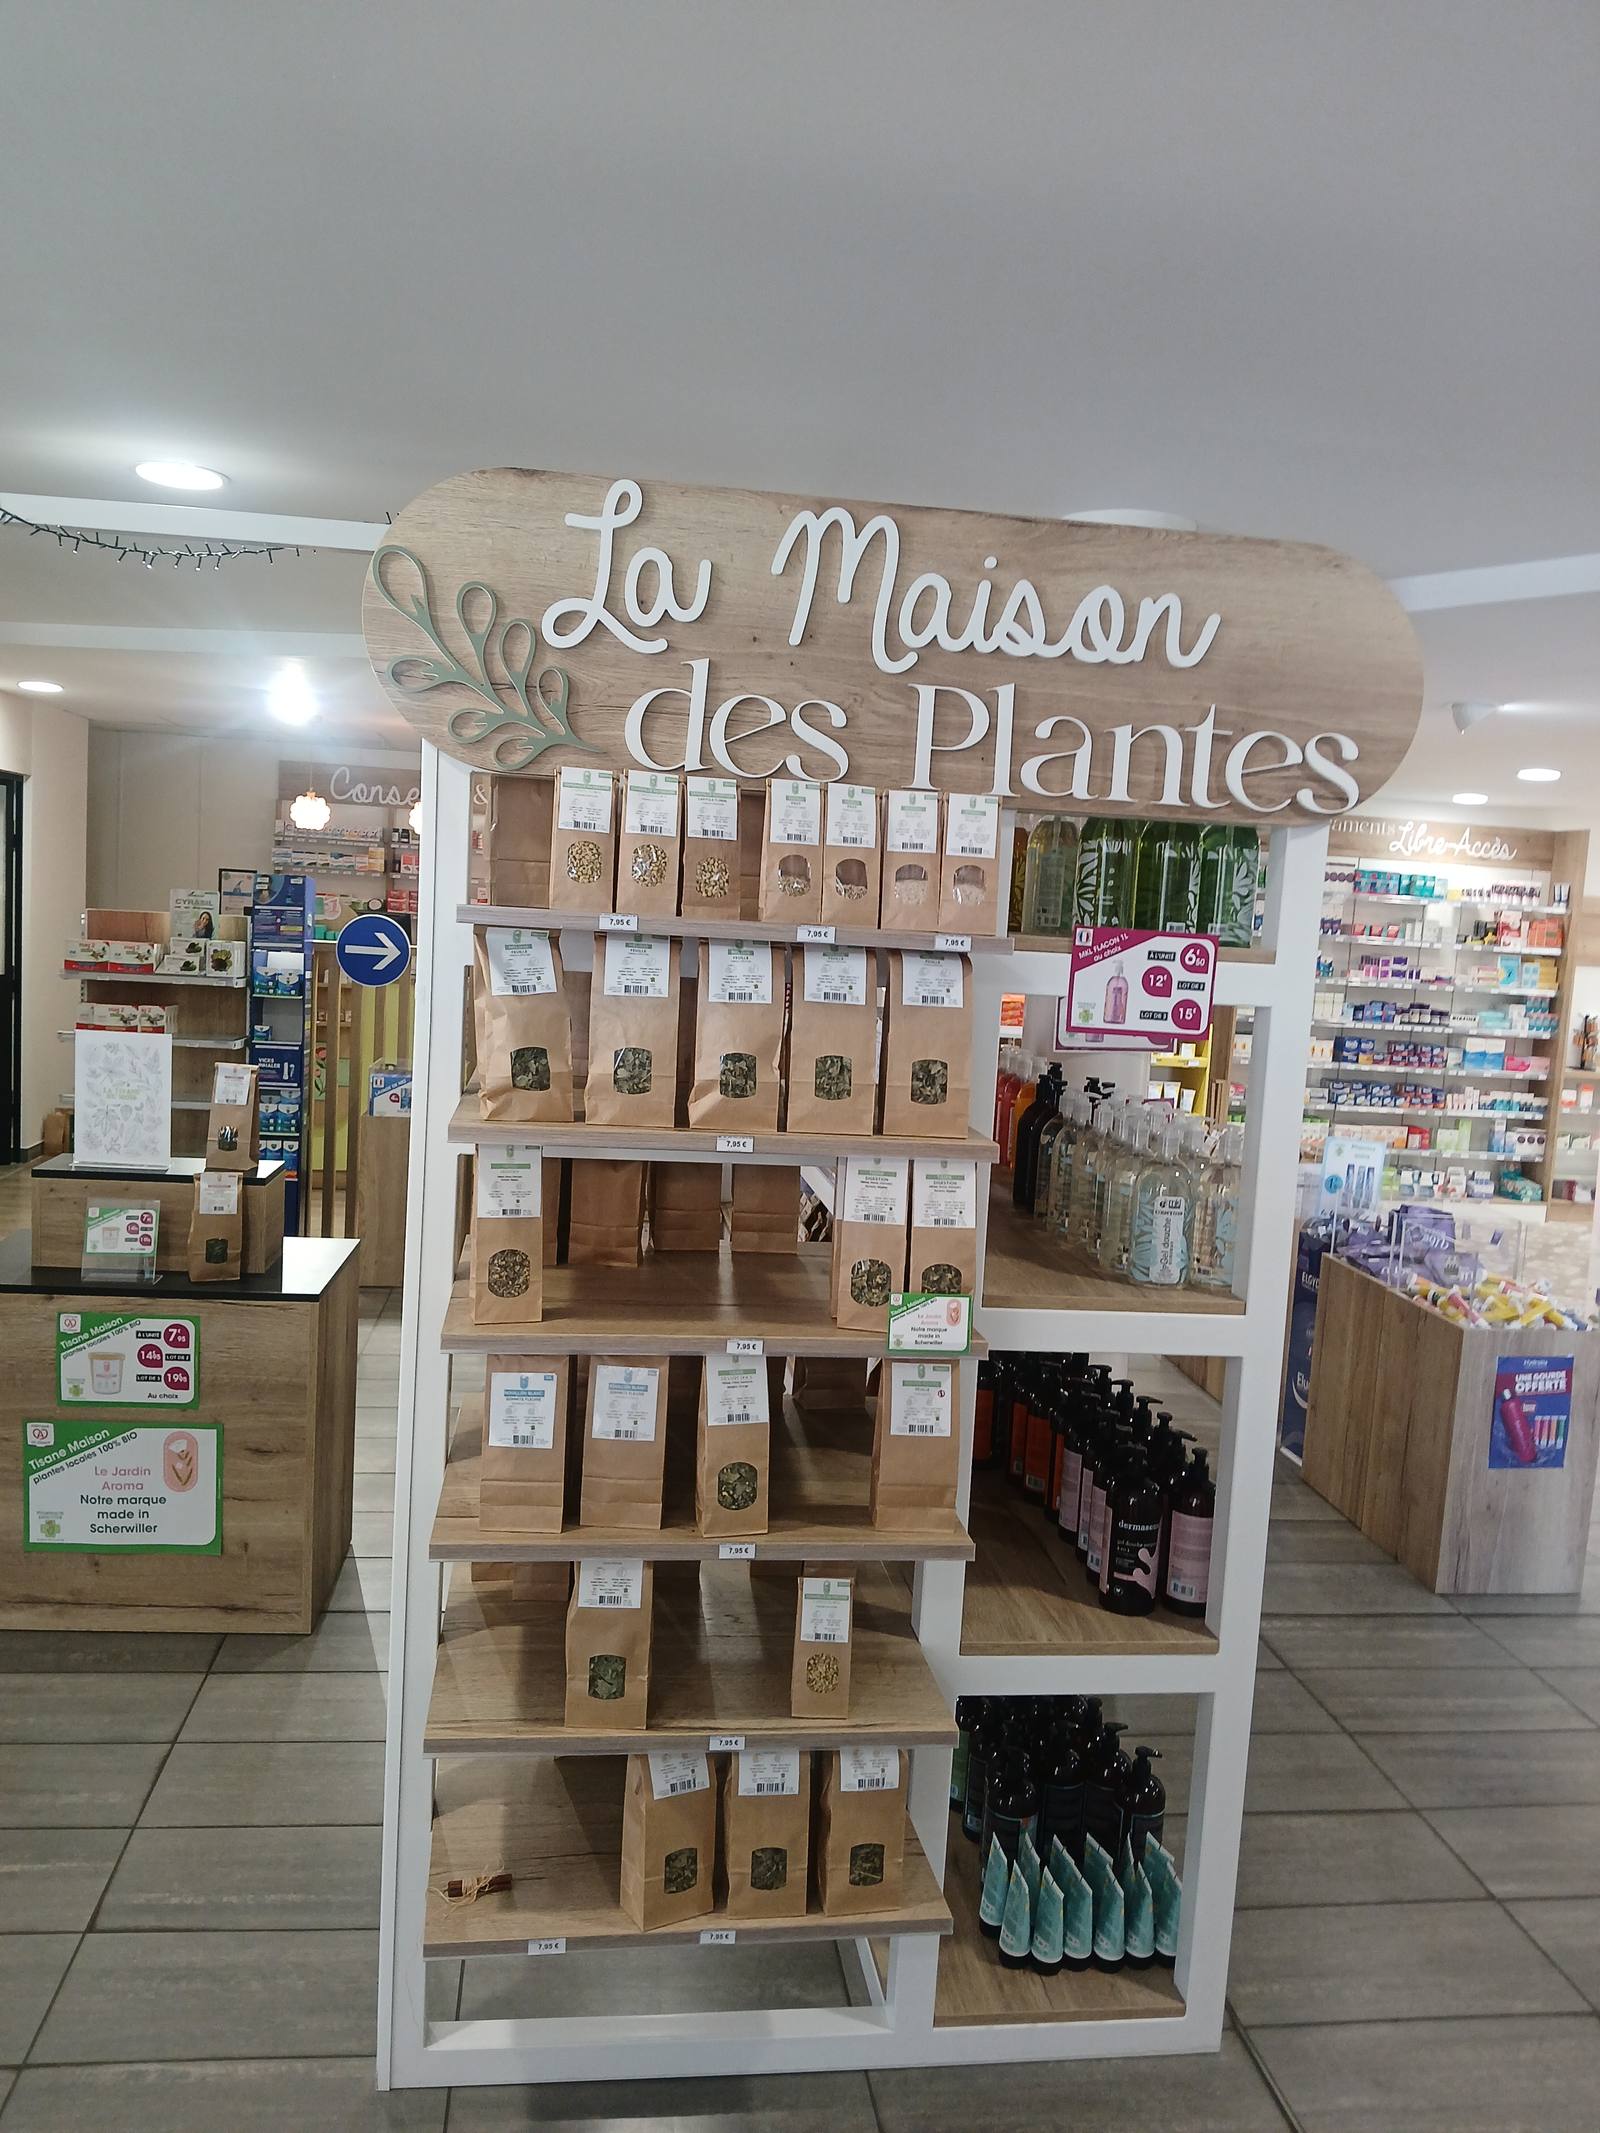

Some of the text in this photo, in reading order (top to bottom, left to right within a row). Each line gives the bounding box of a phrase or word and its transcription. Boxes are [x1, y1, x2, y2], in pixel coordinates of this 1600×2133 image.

[541, 479, 1221, 675] La Maison
[624, 657, 1360, 816] des Plantes
[1388, 820, 1518, 861] Libre-Accès
[1078, 947, 1094, 959] MKL
[1094, 936, 1120, 954] FLACON
[1093, 945, 1122, 962] au choix
[1178, 982, 1190, 990] LOT
[1141, 1011, 1153, 1019] LOT
[61, 1317, 123, 1350] Tisane Maison
[1515, 1370, 1566, 1382] UNE GOURDE
[1515, 1380, 1567, 1393] OFFERTE
[28, 1449, 67, 1471] Tisane
[67, 1428, 110, 1452] Maison
[33, 1431, 138, 1485] plantes locales 100% BIO
[94, 1466, 151, 1477] Le Jardin
[101, 1481, 144, 1491] Aroma
[80, 1494, 167, 1509] Notre marque
[97, 1509, 149, 1519] made in
[89, 1523, 158, 1534] Scherwiller
